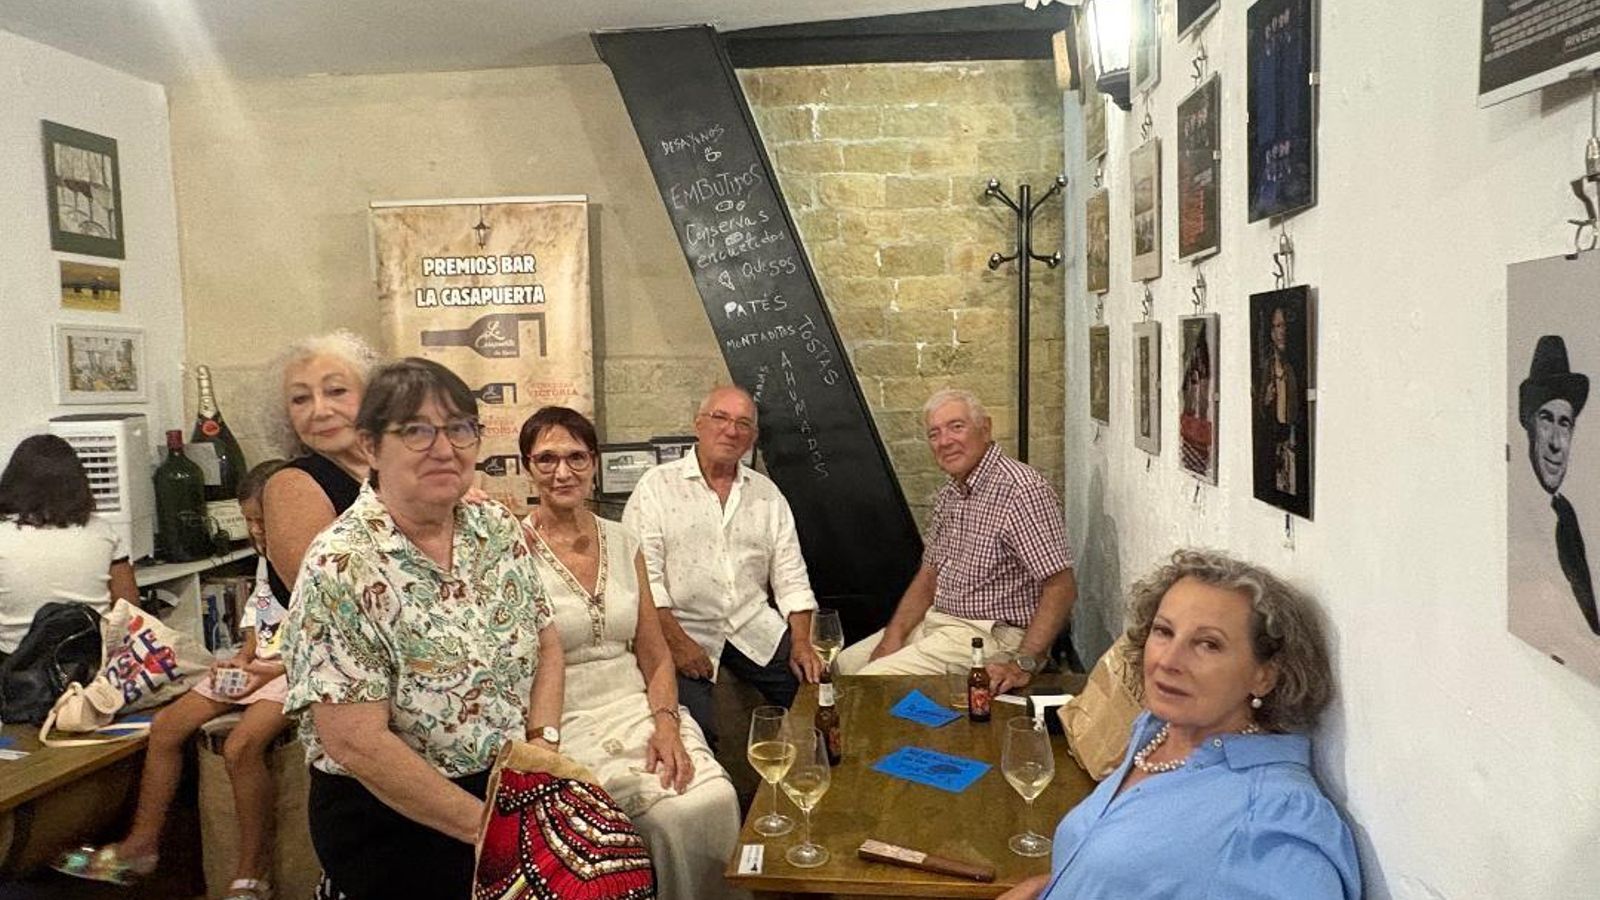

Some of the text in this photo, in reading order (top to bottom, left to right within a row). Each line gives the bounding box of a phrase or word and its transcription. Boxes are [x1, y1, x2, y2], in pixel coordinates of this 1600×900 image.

[422, 254, 536, 277] PREMIOS BAR
[416, 284, 546, 307] LA CASAPUERTA
[798, 314, 839, 386] TOSTAS
